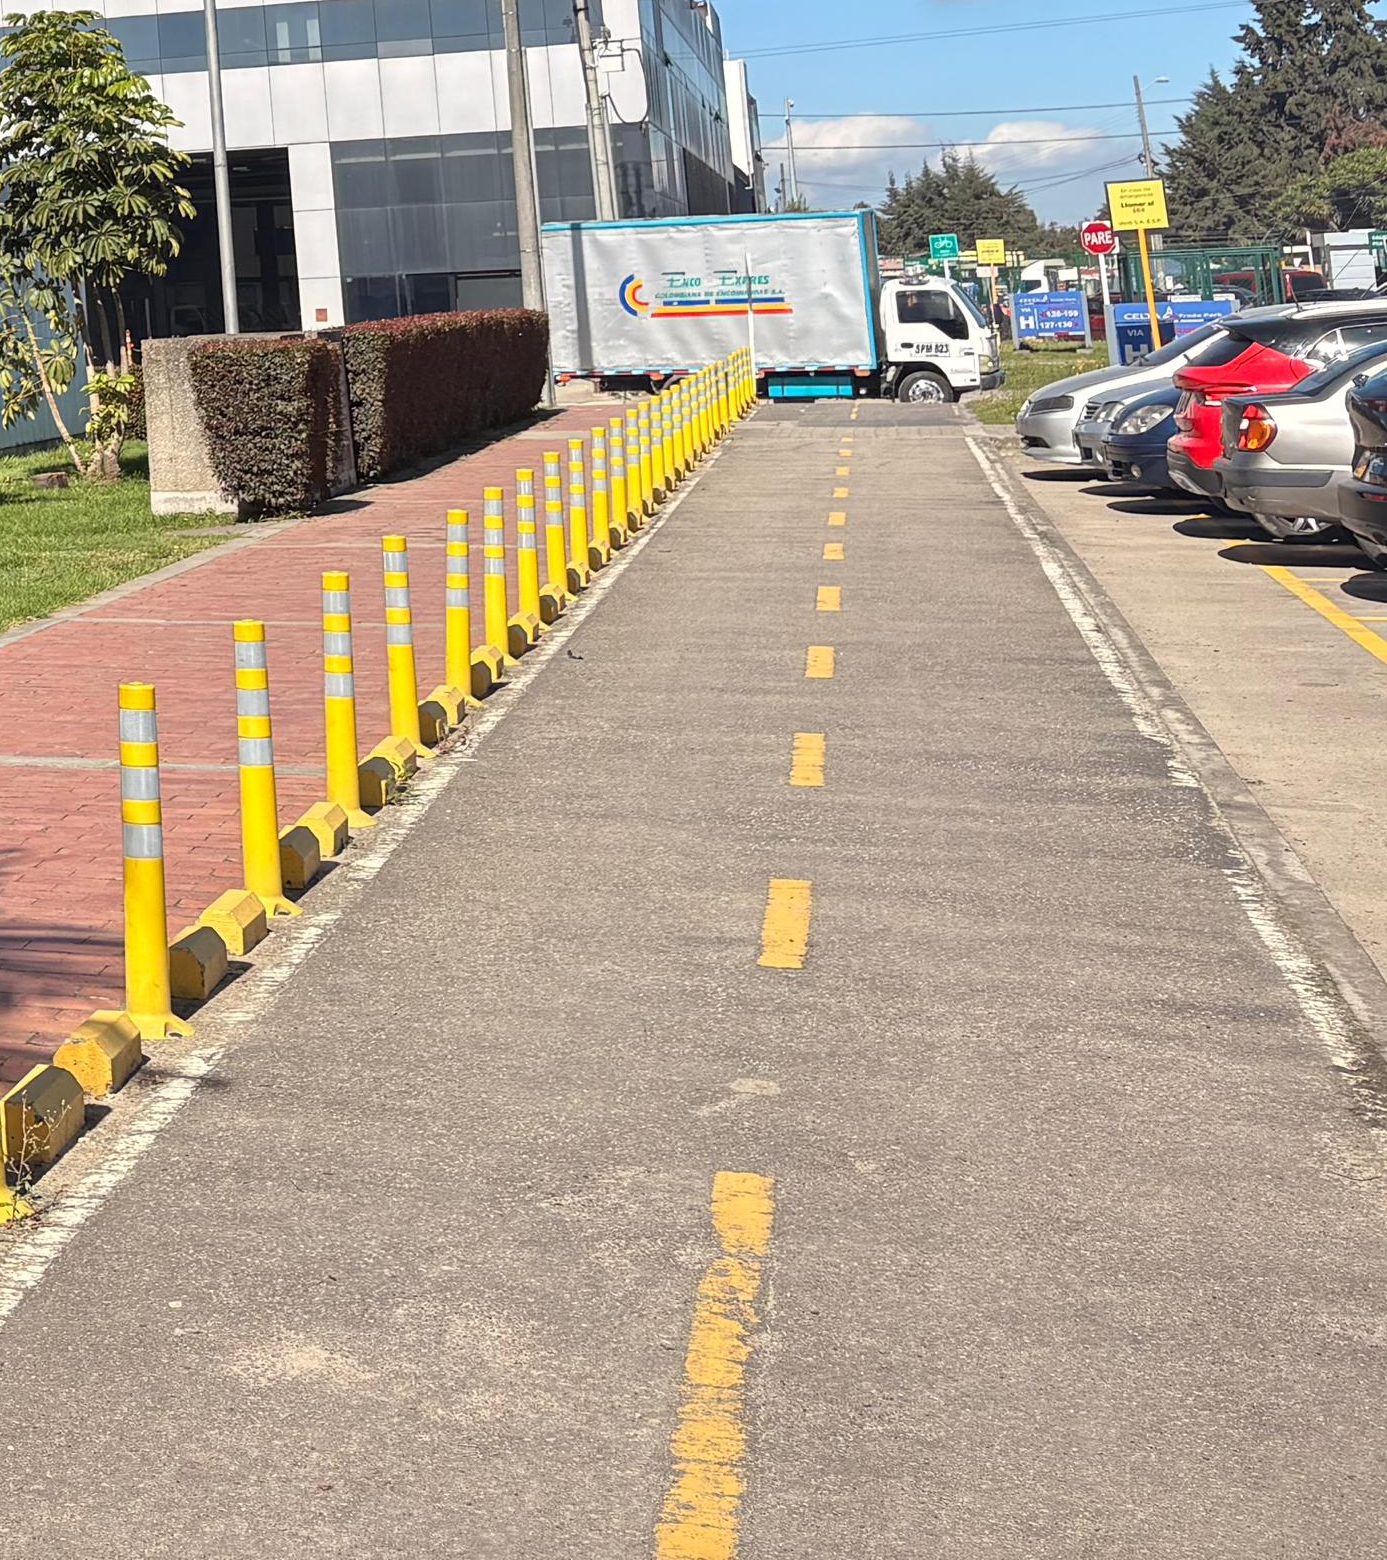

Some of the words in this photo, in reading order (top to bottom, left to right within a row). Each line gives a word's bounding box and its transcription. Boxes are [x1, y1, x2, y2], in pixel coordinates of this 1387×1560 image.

[1084, 231, 1113, 246] PARE
[1019, 315, 1035, 330] H
[1127, 329, 1144, 337] VIA
